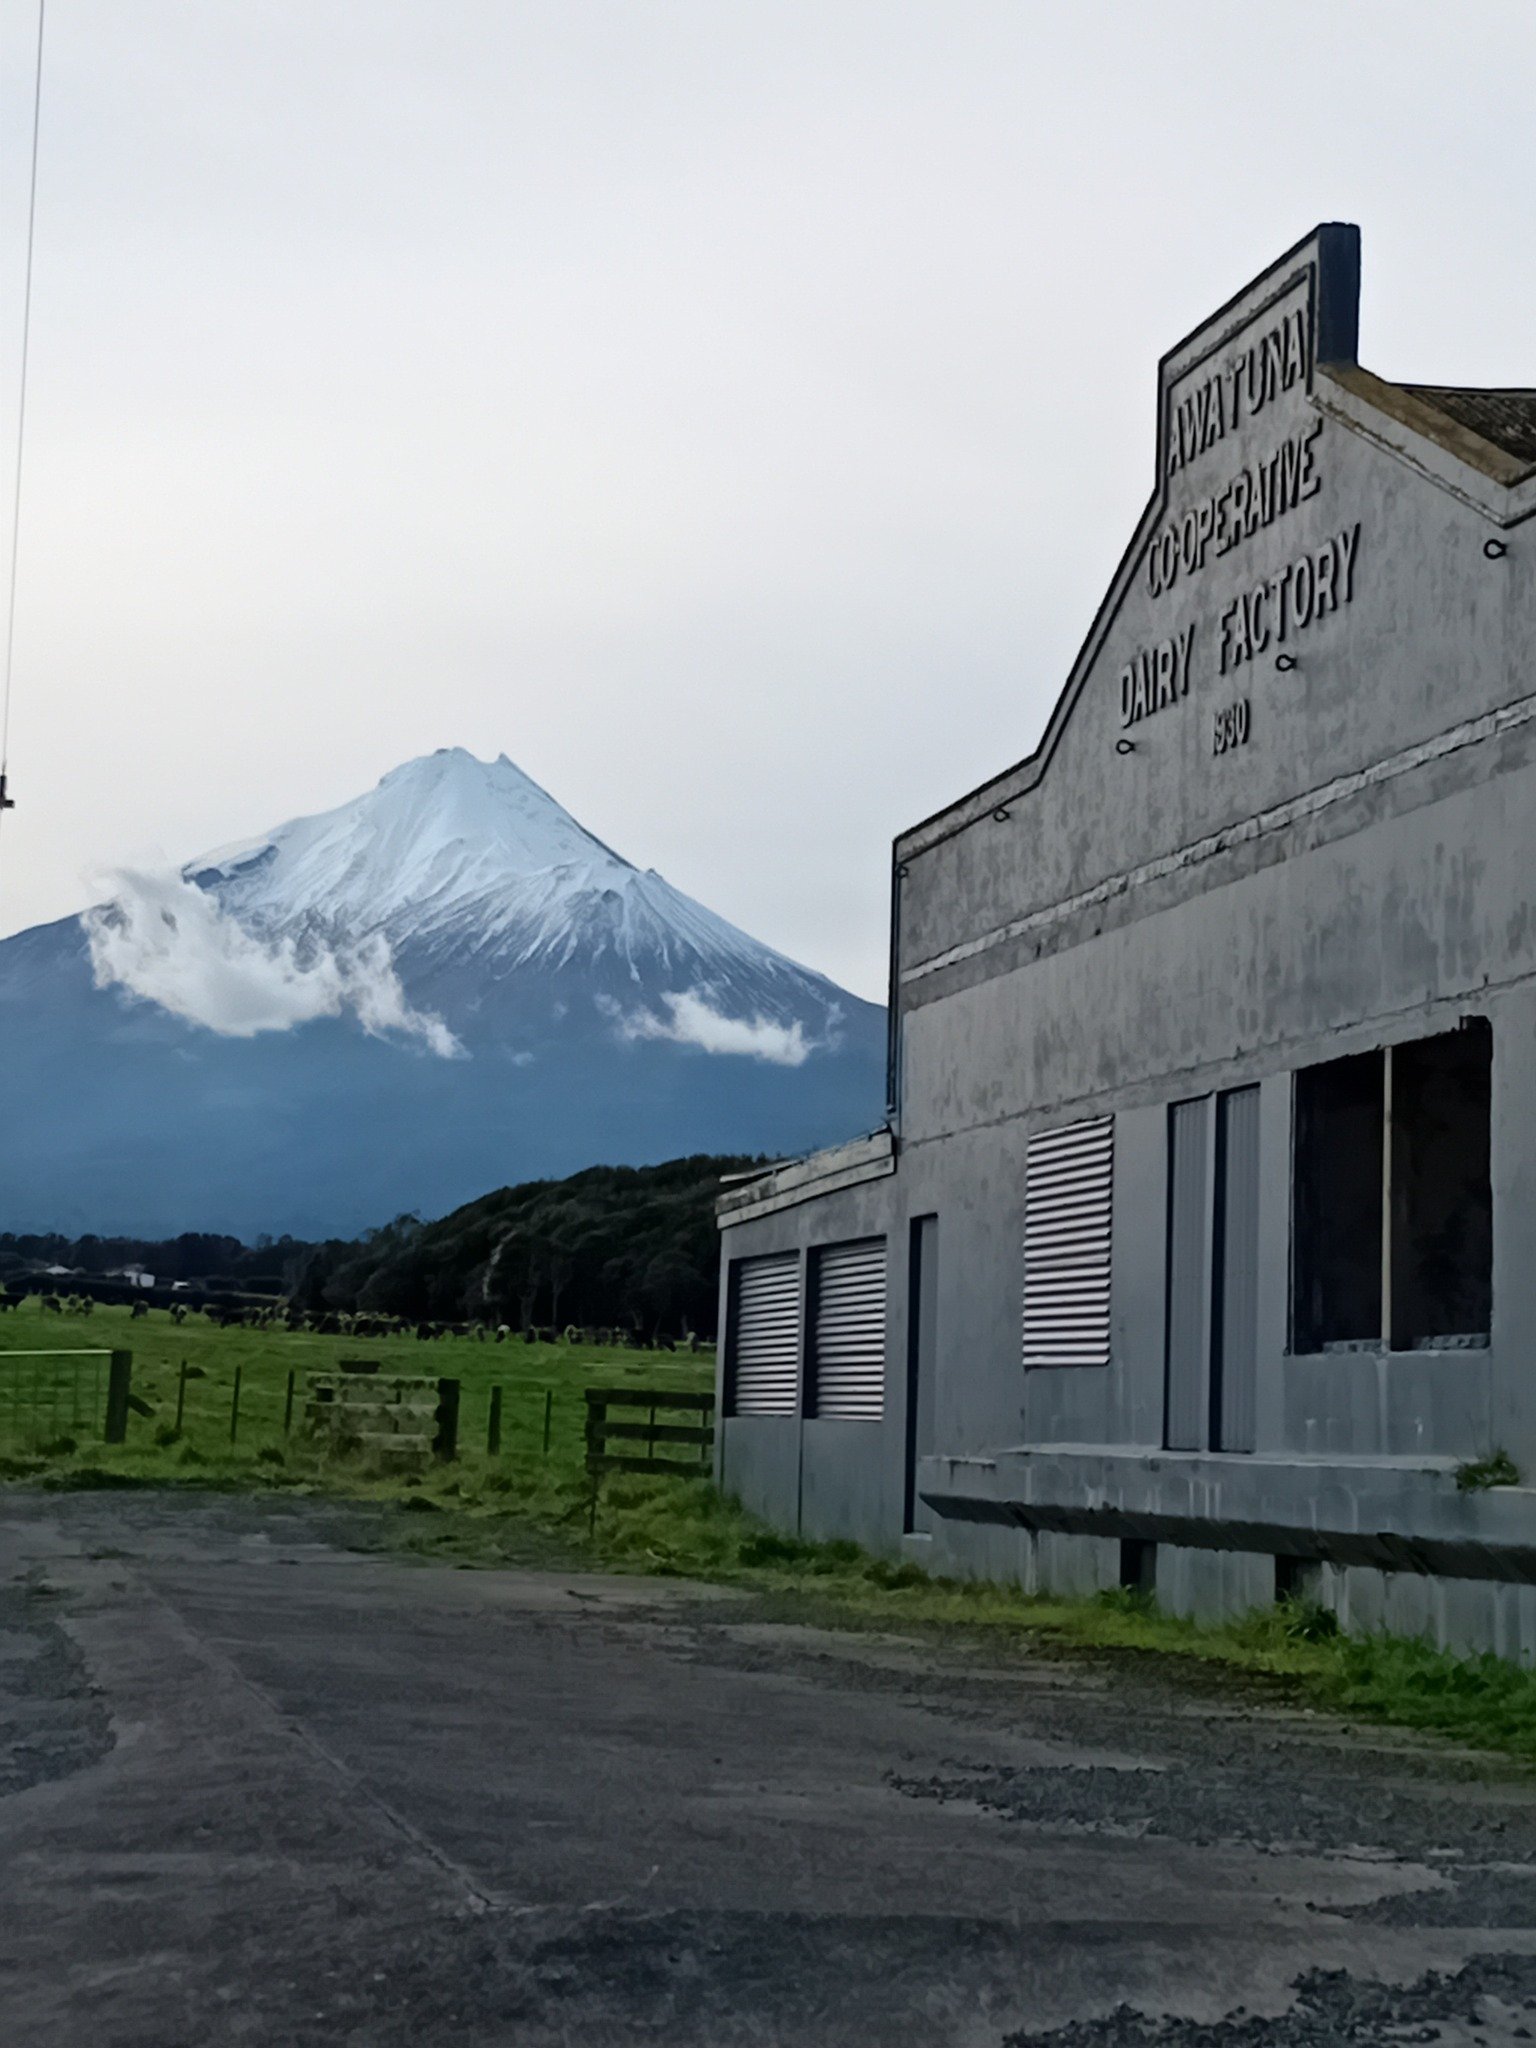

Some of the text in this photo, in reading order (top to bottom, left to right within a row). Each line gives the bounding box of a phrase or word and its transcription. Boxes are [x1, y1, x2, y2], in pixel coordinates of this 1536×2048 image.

[1168, 308, 1305, 477] AWATUNA
[1121, 522, 1361, 729] DAIRY FACTORY
